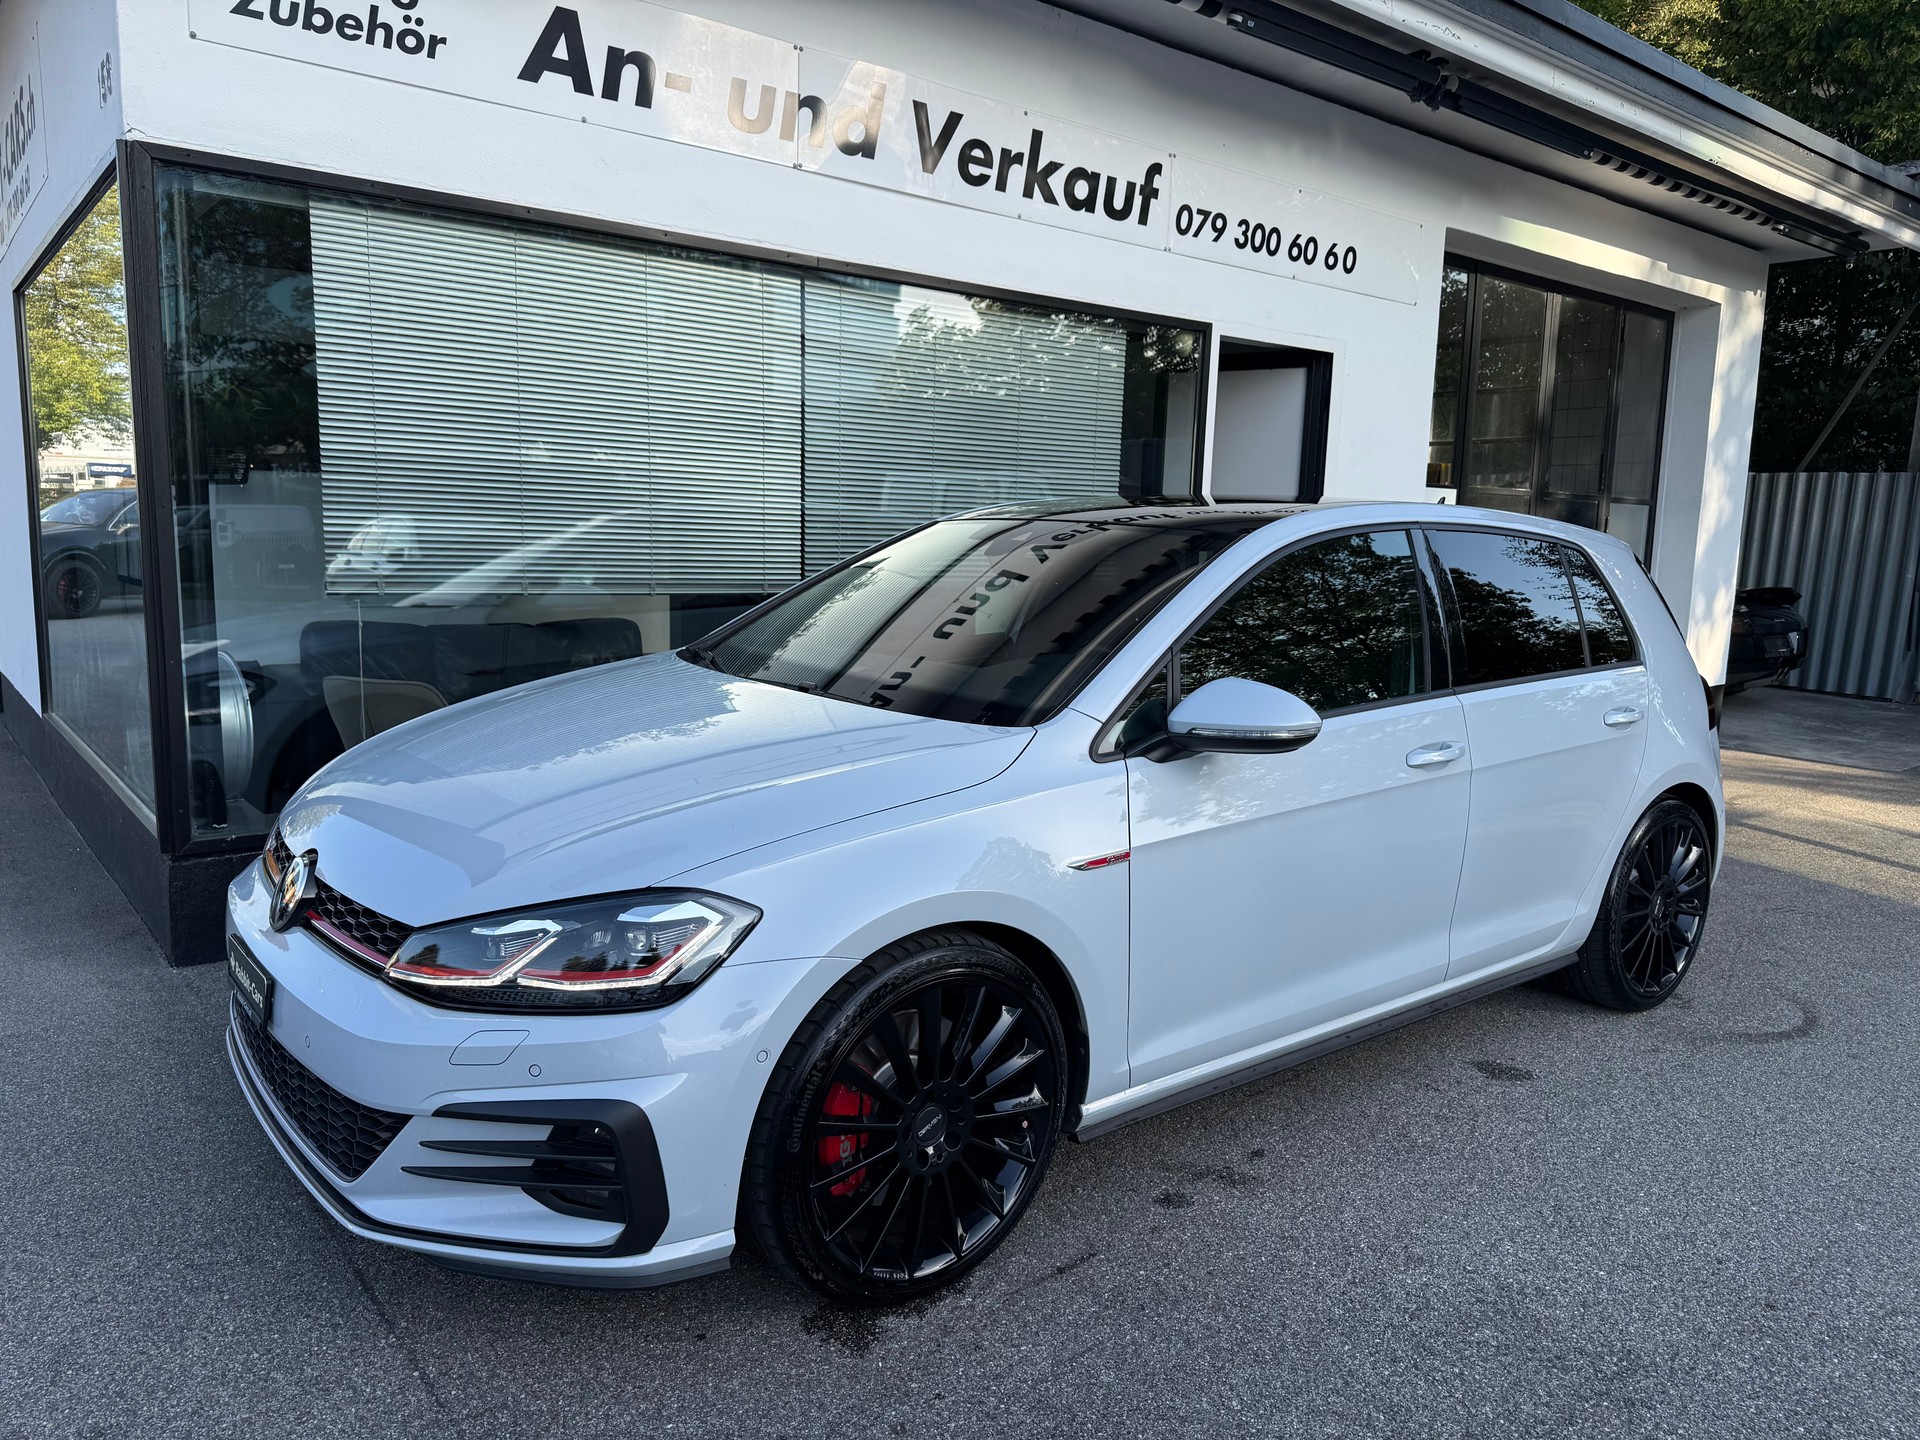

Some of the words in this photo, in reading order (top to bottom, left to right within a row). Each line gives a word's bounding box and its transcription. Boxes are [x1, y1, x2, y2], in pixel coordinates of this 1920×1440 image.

[516, 5, 692, 110] An-
[727, 76, 887, 161] und
[912, 98, 1163, 226] Verkauf
[1175, 203, 1228, 243] 079
[1234, 218, 1282, 257] 300
[1287, 233, 1319, 266] 60
[1324, 242, 1357, 275] 60
[787, 1070, 823, 1153] Continental
